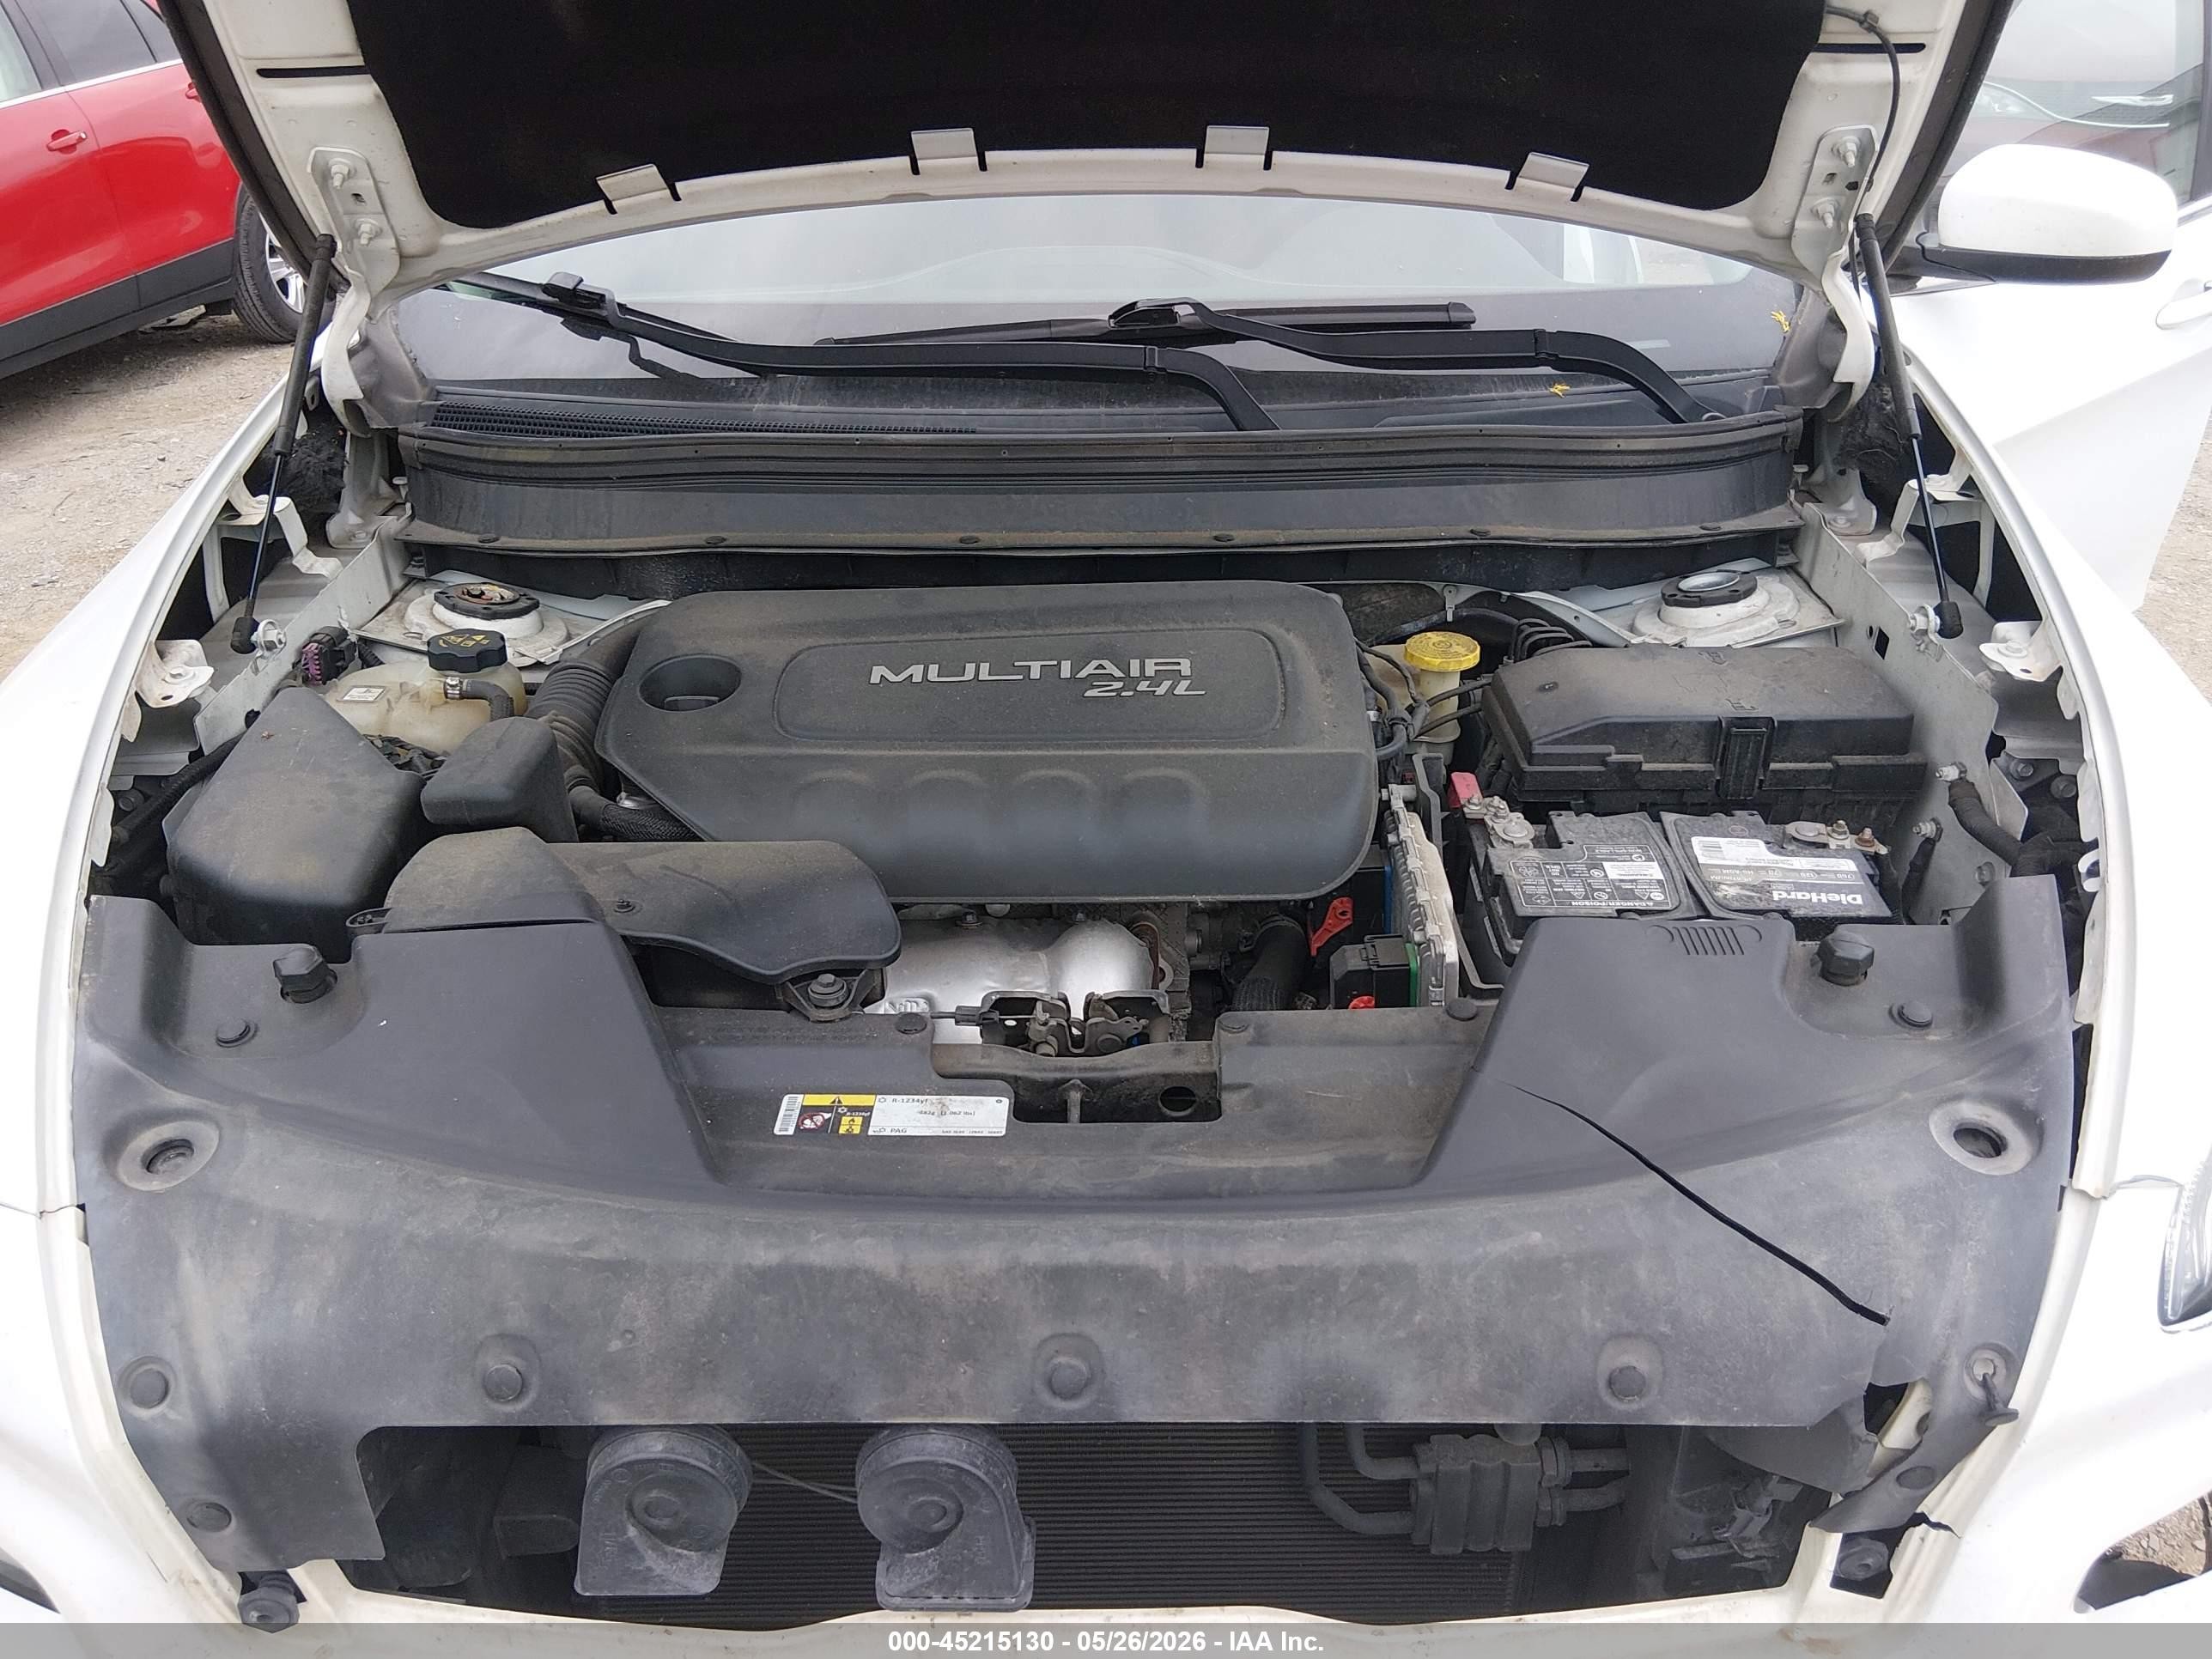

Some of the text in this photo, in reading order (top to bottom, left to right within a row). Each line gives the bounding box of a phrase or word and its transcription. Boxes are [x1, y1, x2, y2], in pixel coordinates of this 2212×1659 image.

[869, 658, 1193, 684] MULTIAIR
[1083, 678, 1207, 698] 2.4L
[1771, 890, 1863, 906] DieHard
[891, 1097, 929, 1106] R-1234yf
